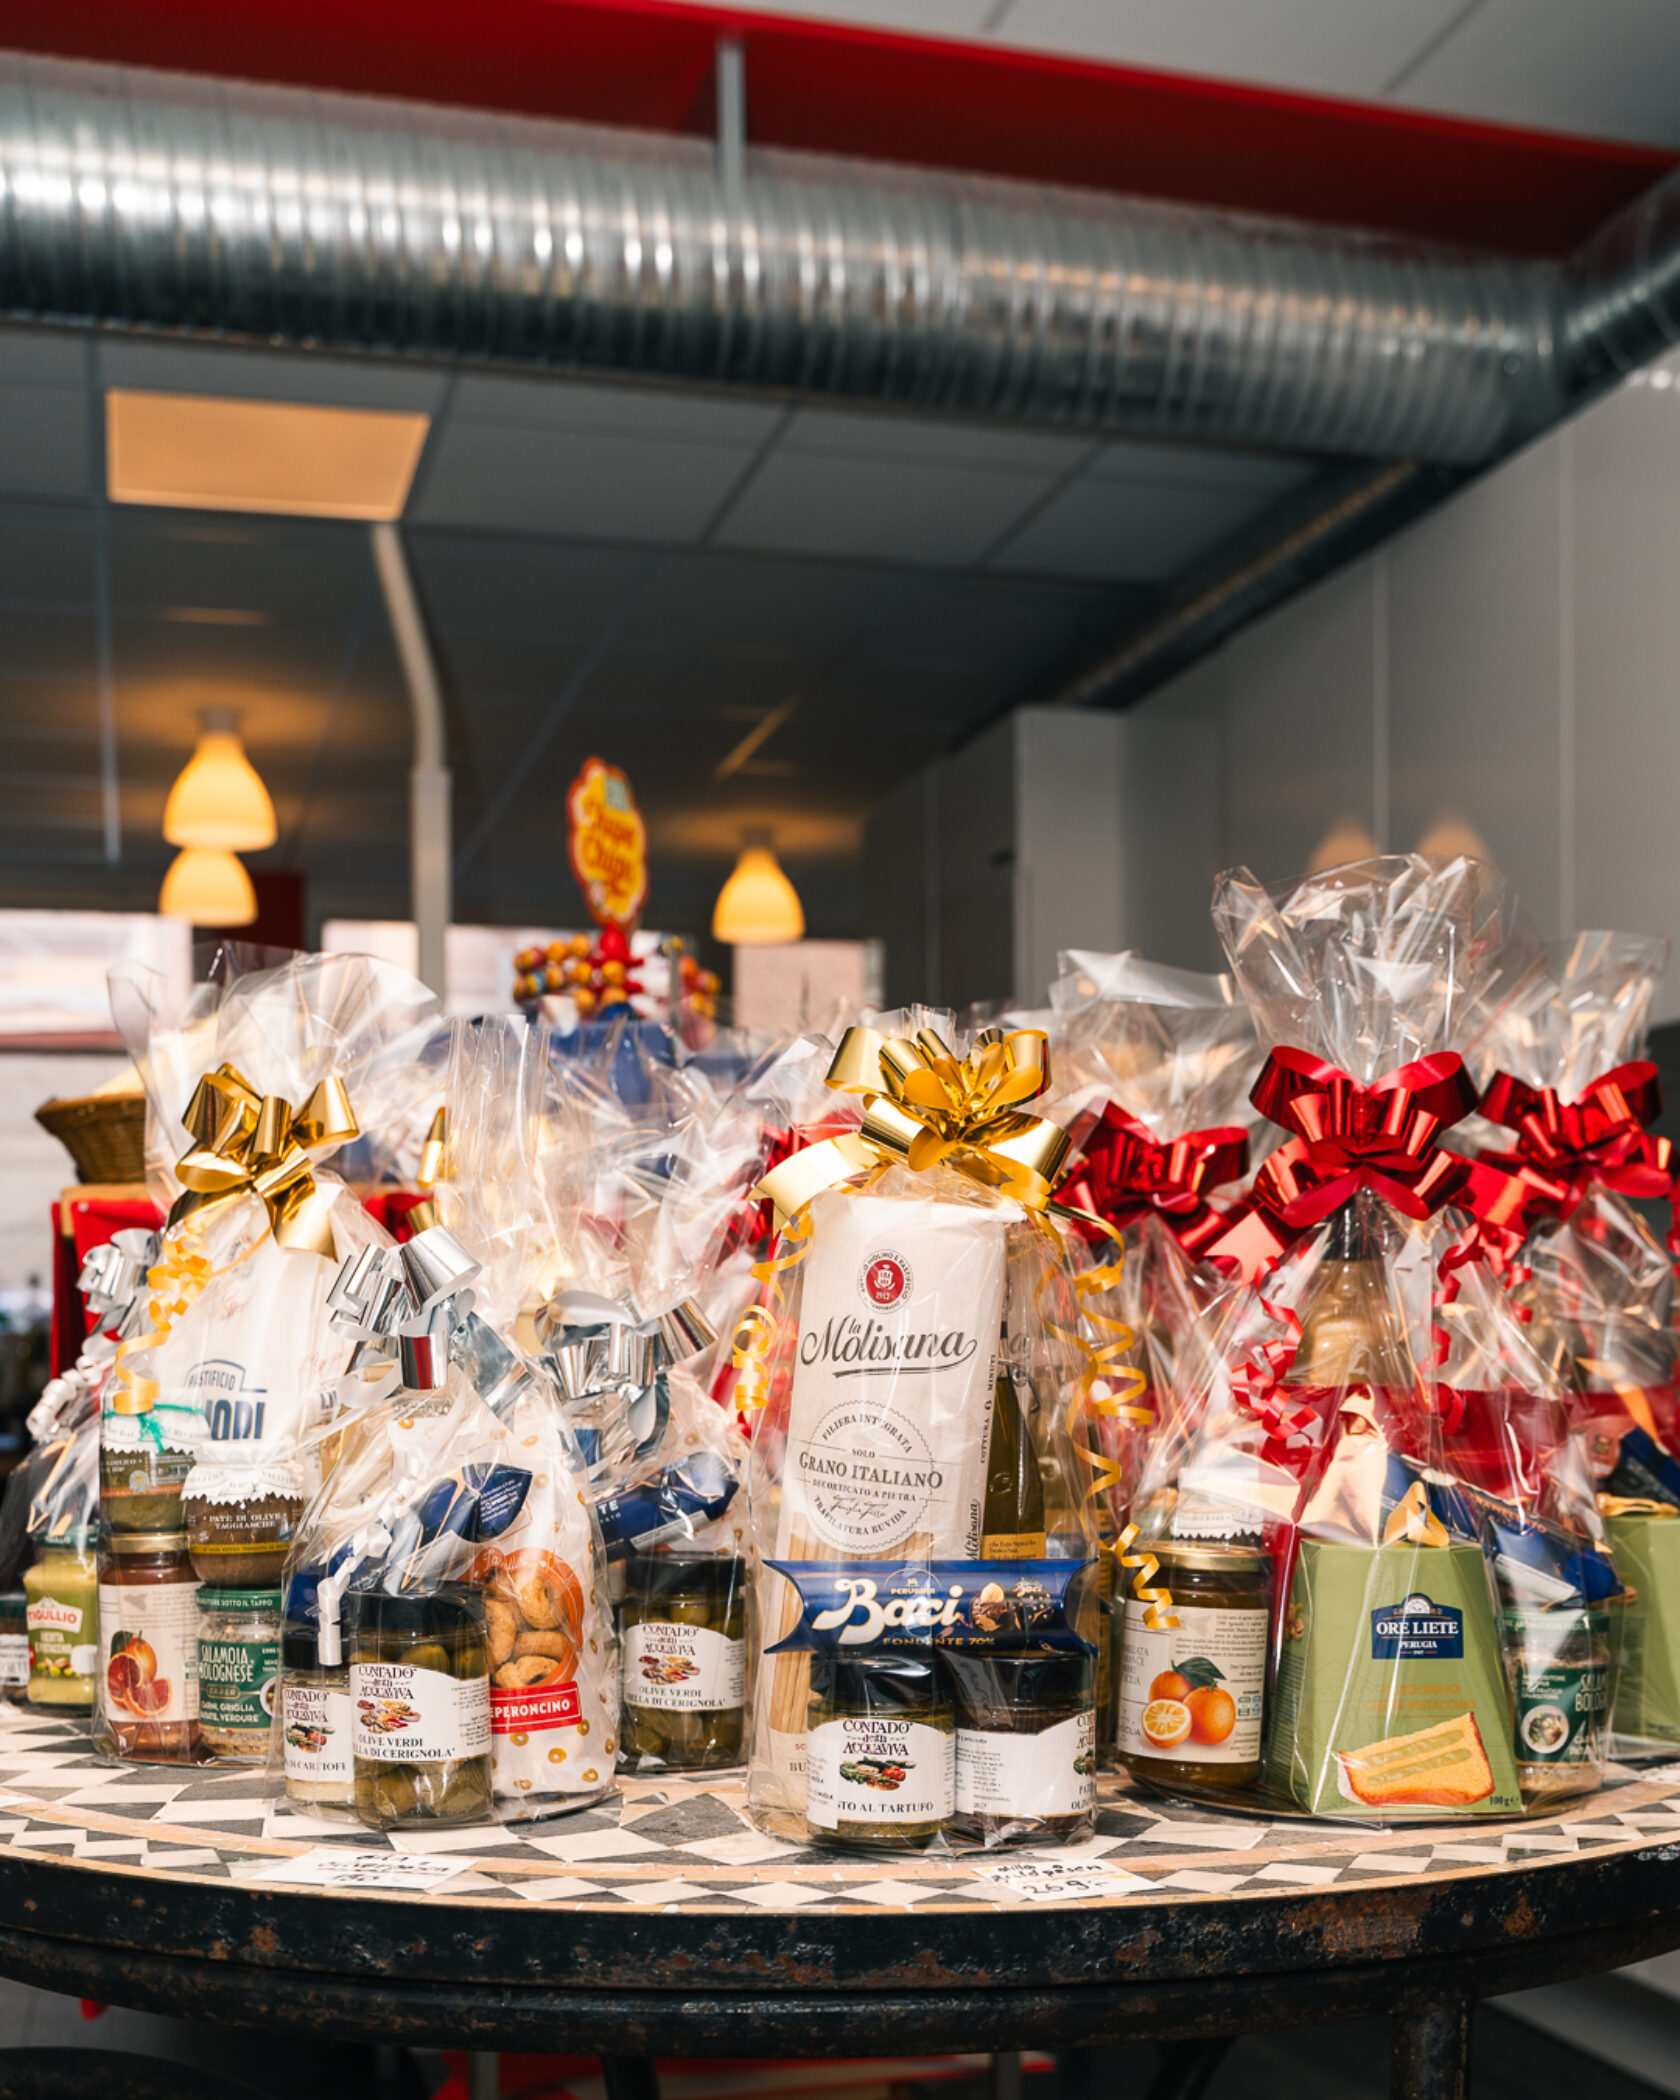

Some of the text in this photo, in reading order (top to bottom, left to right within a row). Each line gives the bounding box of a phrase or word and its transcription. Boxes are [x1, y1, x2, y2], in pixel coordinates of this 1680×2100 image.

[848, 1317, 862, 1334] la
[801, 1314, 978, 1366] Molisana
[188, 1369, 237, 1391] PASTIFICIO
[822, 1414, 857, 1441] FILIERA
[851, 1448, 876, 1459] SOLO
[799, 1451, 944, 1490] GRANO ITALIANO
[873, 1490, 879, 1498] A
[881, 1491, 917, 1502] PIETRA
[871, 1508, 909, 1535] RUVIDA
[27, 1608, 78, 1625] TIGULLIO
[811, 1578, 964, 1646] Baci
[642, 1624, 698, 1638] CONTADO
[1375, 1621, 1460, 1635] ORE LIETE
[1399, 1640, 1438, 1649] PERUGIA
[201, 1644, 249, 1665] SALAMOIA
[199, 1662, 254, 1683] BOLOGNESE
[359, 1665, 415, 1680] CONTADO
[669, 1687, 703, 1698] VERDI
[1408, 1698, 1477, 1711] PISTACCHIO
[842, 1719, 910, 1735] CONTADO
[358, 1734, 424, 1747] OLIVE VERDI
[371, 1747, 381, 1758] DI
[842, 1741, 910, 1757] ACQUAVIVA
[859, 1802, 874, 1813] AL
[879, 1801, 934, 1814] TARTUFO
